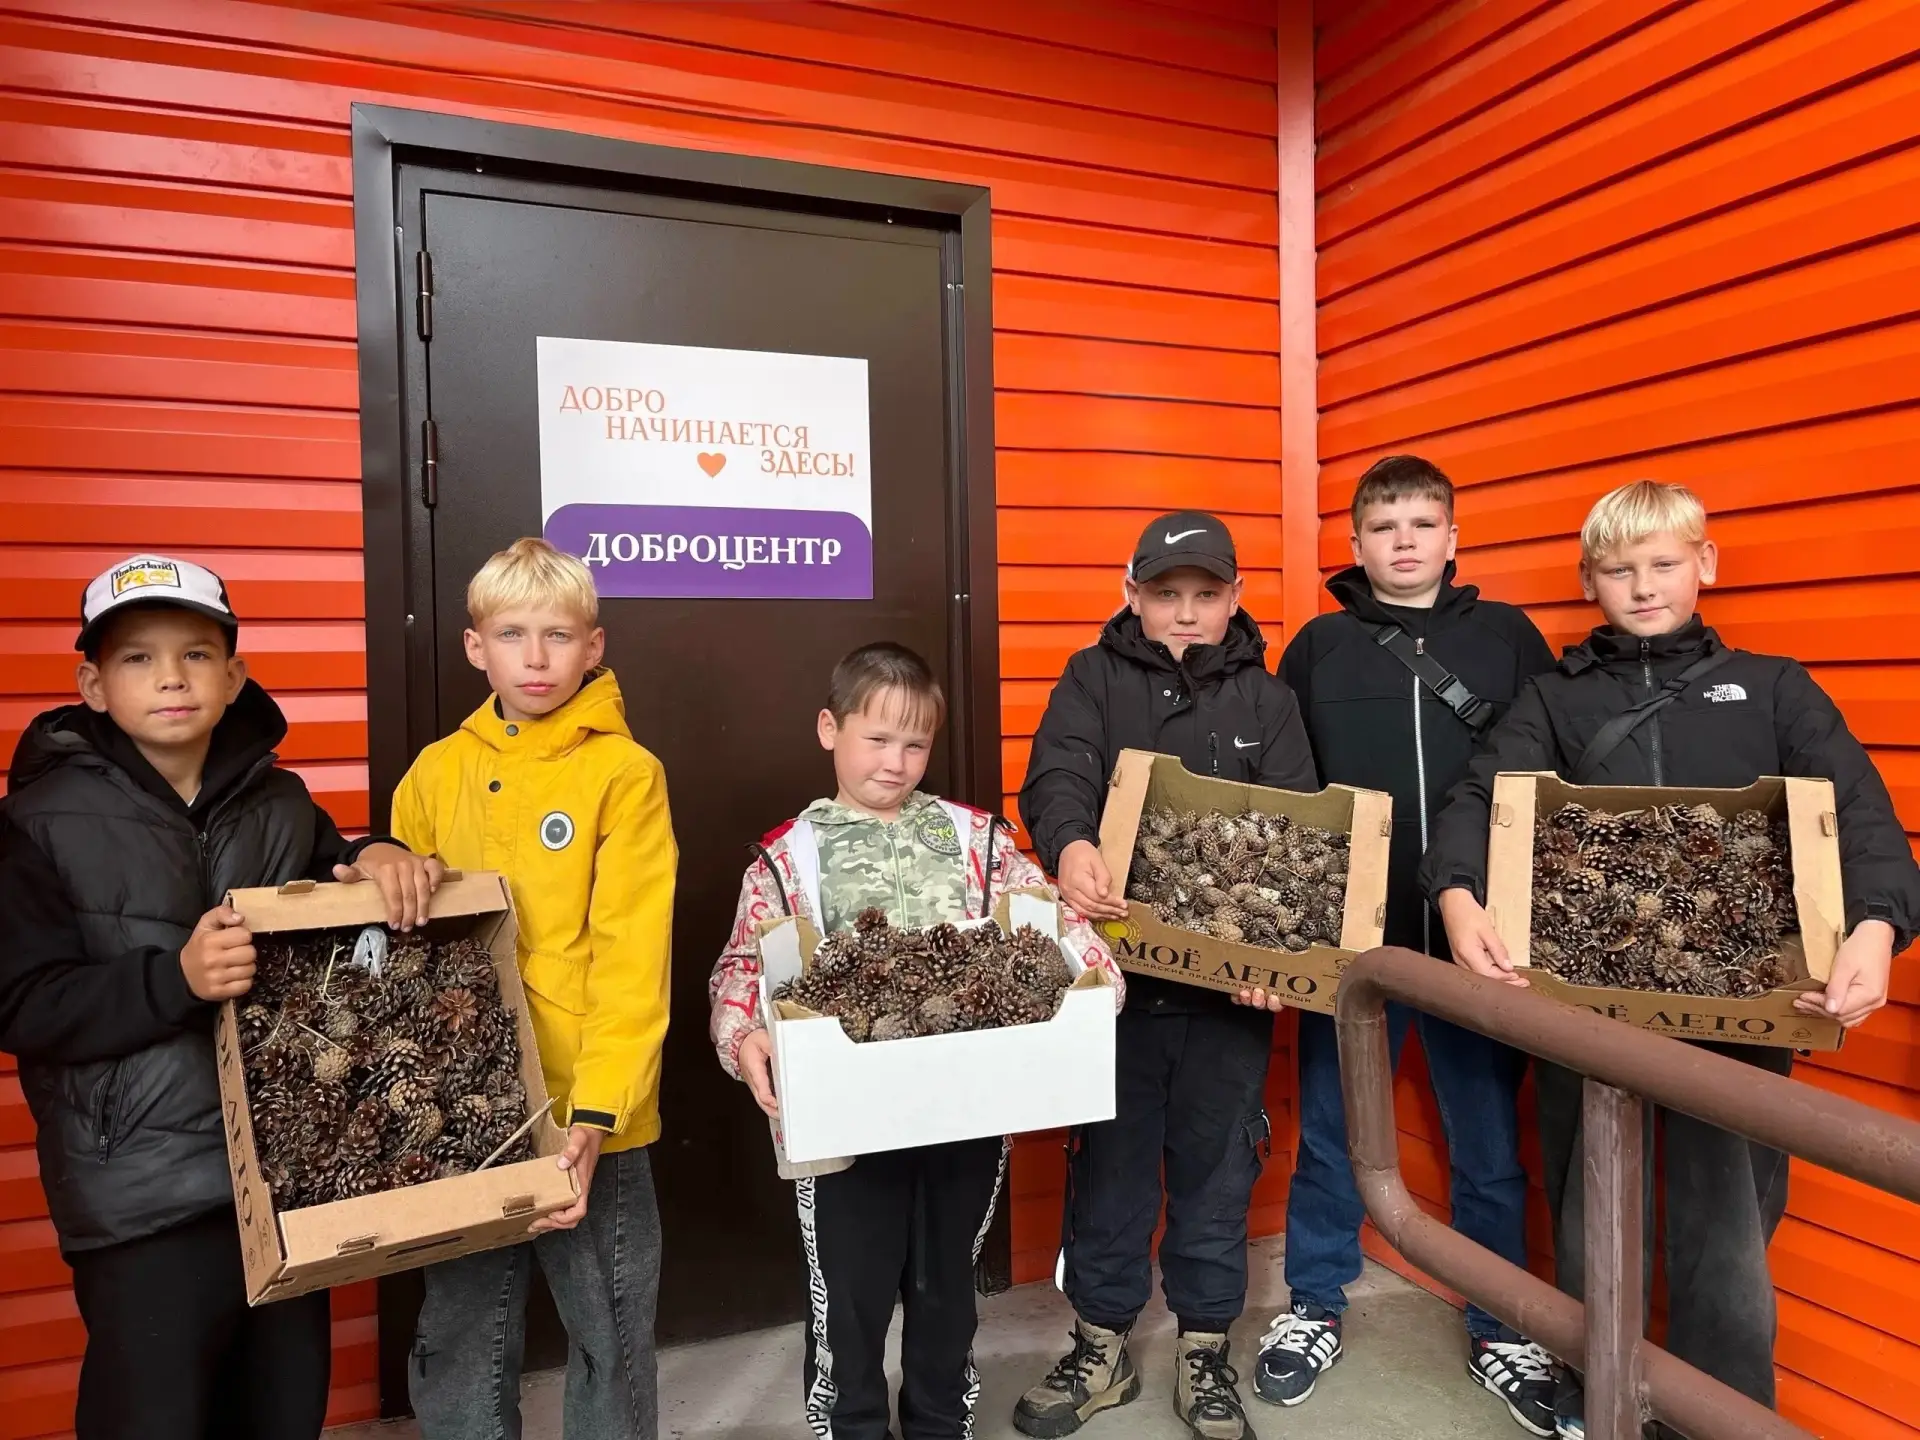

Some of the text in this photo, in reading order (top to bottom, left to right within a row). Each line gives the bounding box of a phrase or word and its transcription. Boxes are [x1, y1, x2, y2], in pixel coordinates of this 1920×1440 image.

[560, 385, 665, 415] ДОБРО
[605, 415, 810, 449] НАЧИНАЕТСЯ
[760, 449, 855, 479] ЗДЕСЬ!
[581, 533, 842, 570] ДОБРОЦЕНТР
[114, 561, 173, 579] Timberland
[1115, 936, 1201, 972] МОЁ
[1210, 960, 1317, 995] ЛЕТО
[1188, 972, 1263, 992] ПРЕМИАЛЬН
[1644, 1010, 1775, 1034] ЛЕТО
